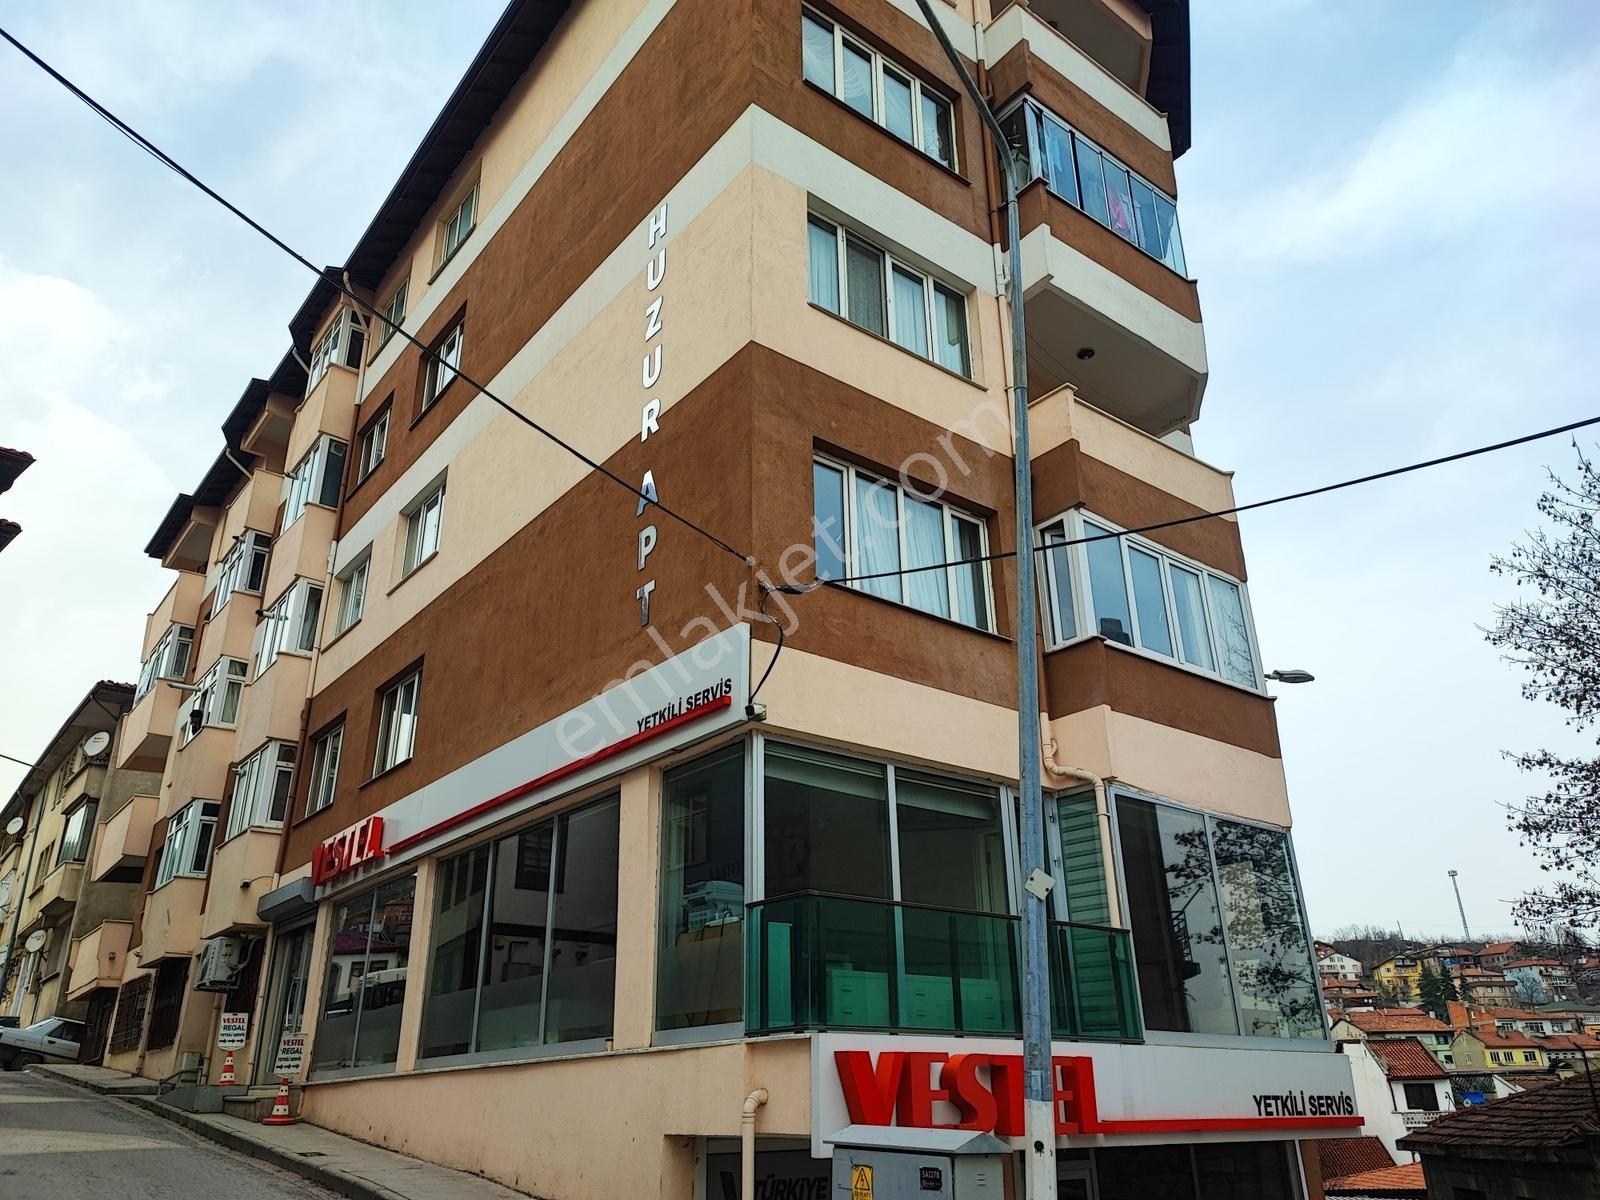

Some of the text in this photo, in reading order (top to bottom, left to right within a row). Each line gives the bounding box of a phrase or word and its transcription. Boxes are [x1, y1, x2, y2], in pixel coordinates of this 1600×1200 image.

[636, 202, 667, 627] HUZUR APT
[637, 678, 732, 733] YETKİLİ SERVİS
[1252, 1090, 1354, 1117] YETKİLİ SERVİS
